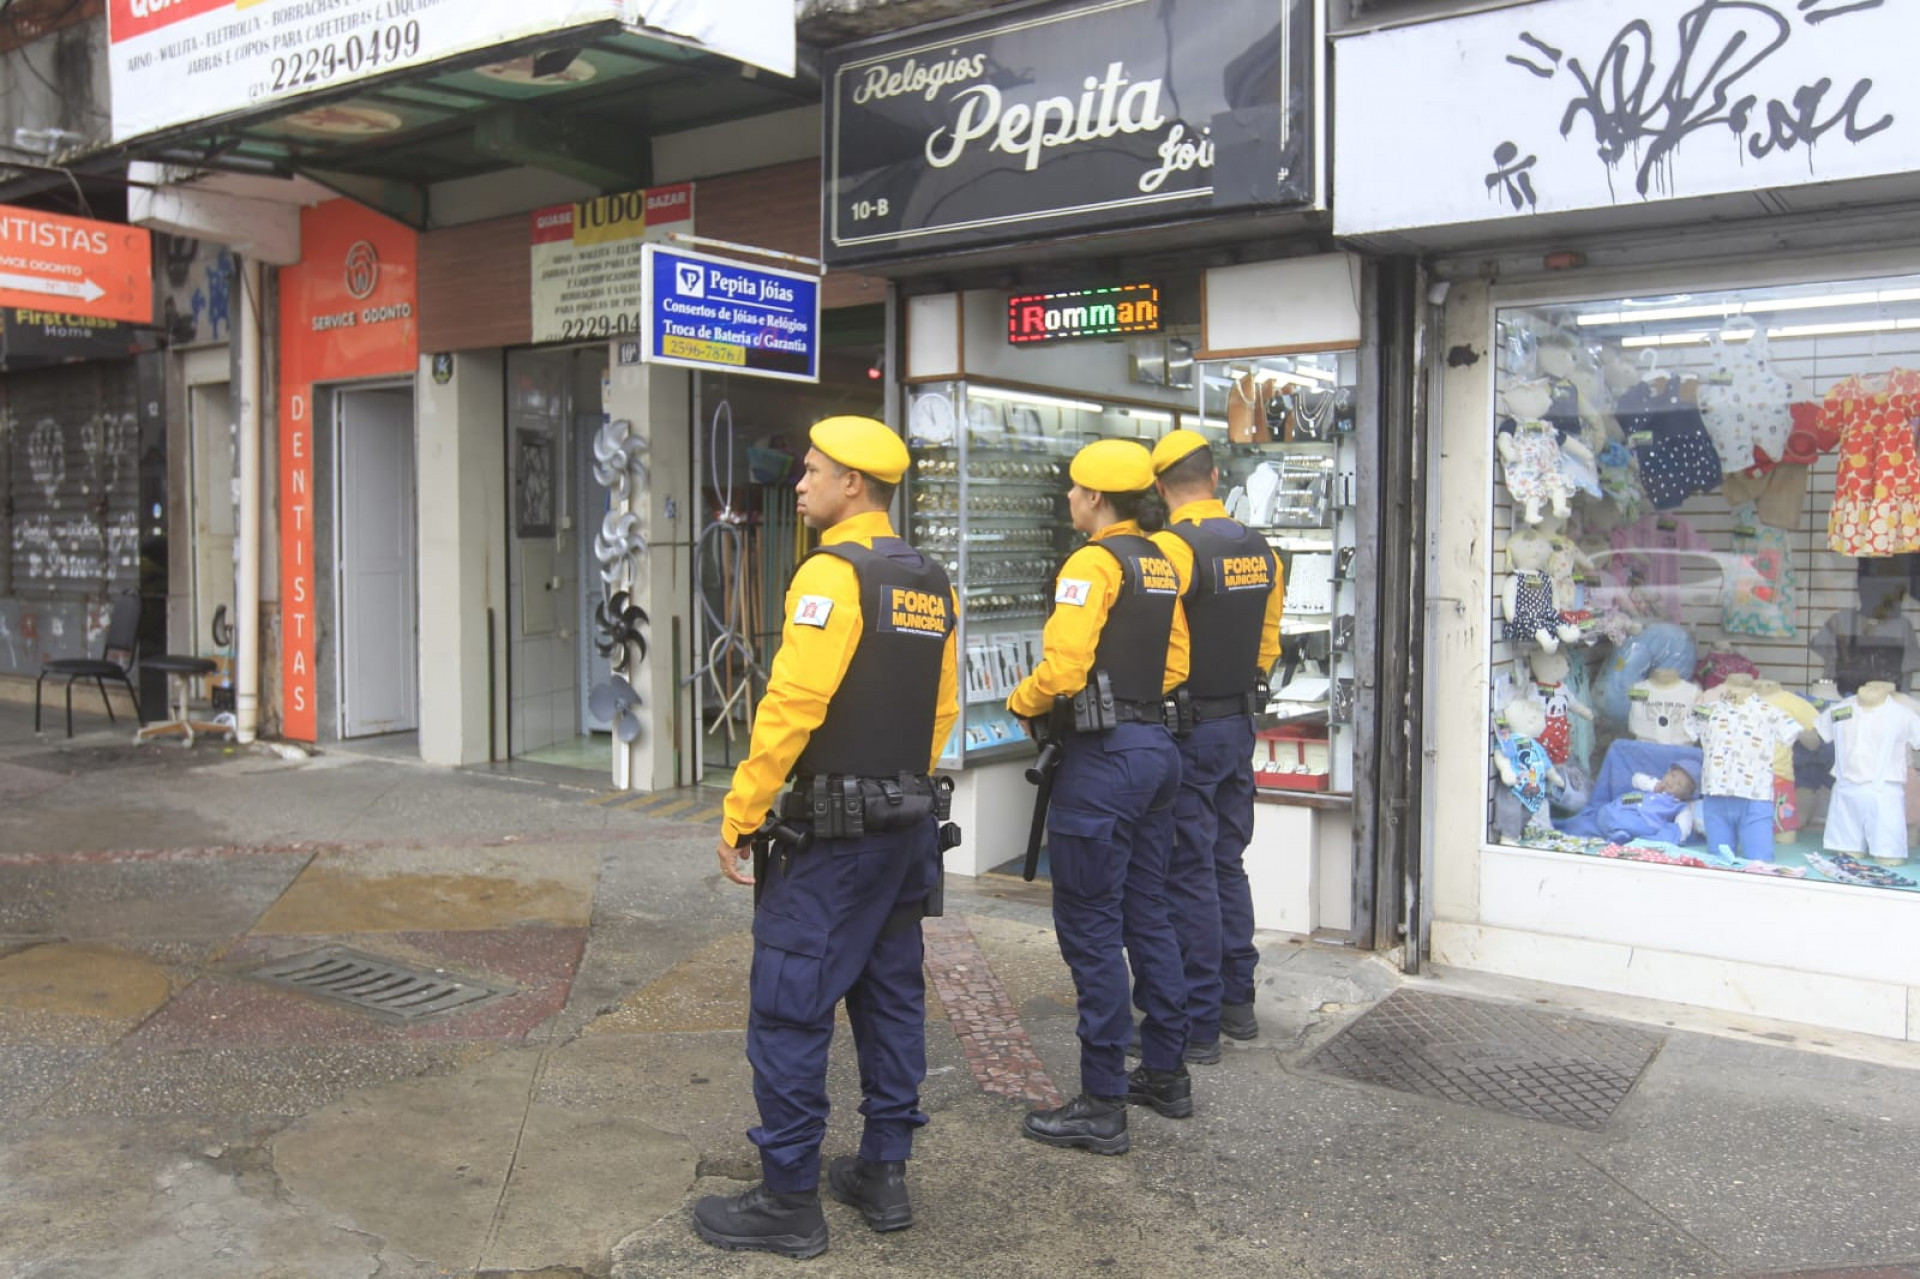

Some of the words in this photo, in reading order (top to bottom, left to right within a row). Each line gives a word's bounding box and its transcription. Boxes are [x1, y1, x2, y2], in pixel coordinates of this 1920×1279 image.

[271, 19, 420, 91] 2229-0499
[272, 30, 302, 51] PARA
[925, 62, 1167, 170] Pepita
[537, 212, 572, 229] QUASE
[576, 192, 643, 229] TUDO
[647, 191, 686, 209] BAZAR
[852, 198, 889, 220] 10-B
[687, 272, 697, 289] P
[710, 270, 756, 298] Pepita
[759, 279, 794, 302] Jóias
[312, 312, 356, 331] SERVICE
[362, 302, 411, 324] ODONTO
[663, 298, 716, 318] Consertos
[718, 307, 732, 321] de
[732, 309, 758, 325] Jóias
[758, 317, 765, 326] e
[767, 314, 808, 333] Relógios
[1022, 300, 1153, 333] Romman
[45, 325, 92, 338] Home
[663, 320, 695, 337] Troca
[698, 325, 712, 340] de
[714, 327, 751, 346] Bateria
[764, 334, 807, 352] Garantia
[291, 395, 306, 712] DENTISTAS
[1223, 556, 1267, 575] FORÇA
[892, 588, 945, 617] FORÇA
[892, 611, 946, 632] MUNICIPAL
